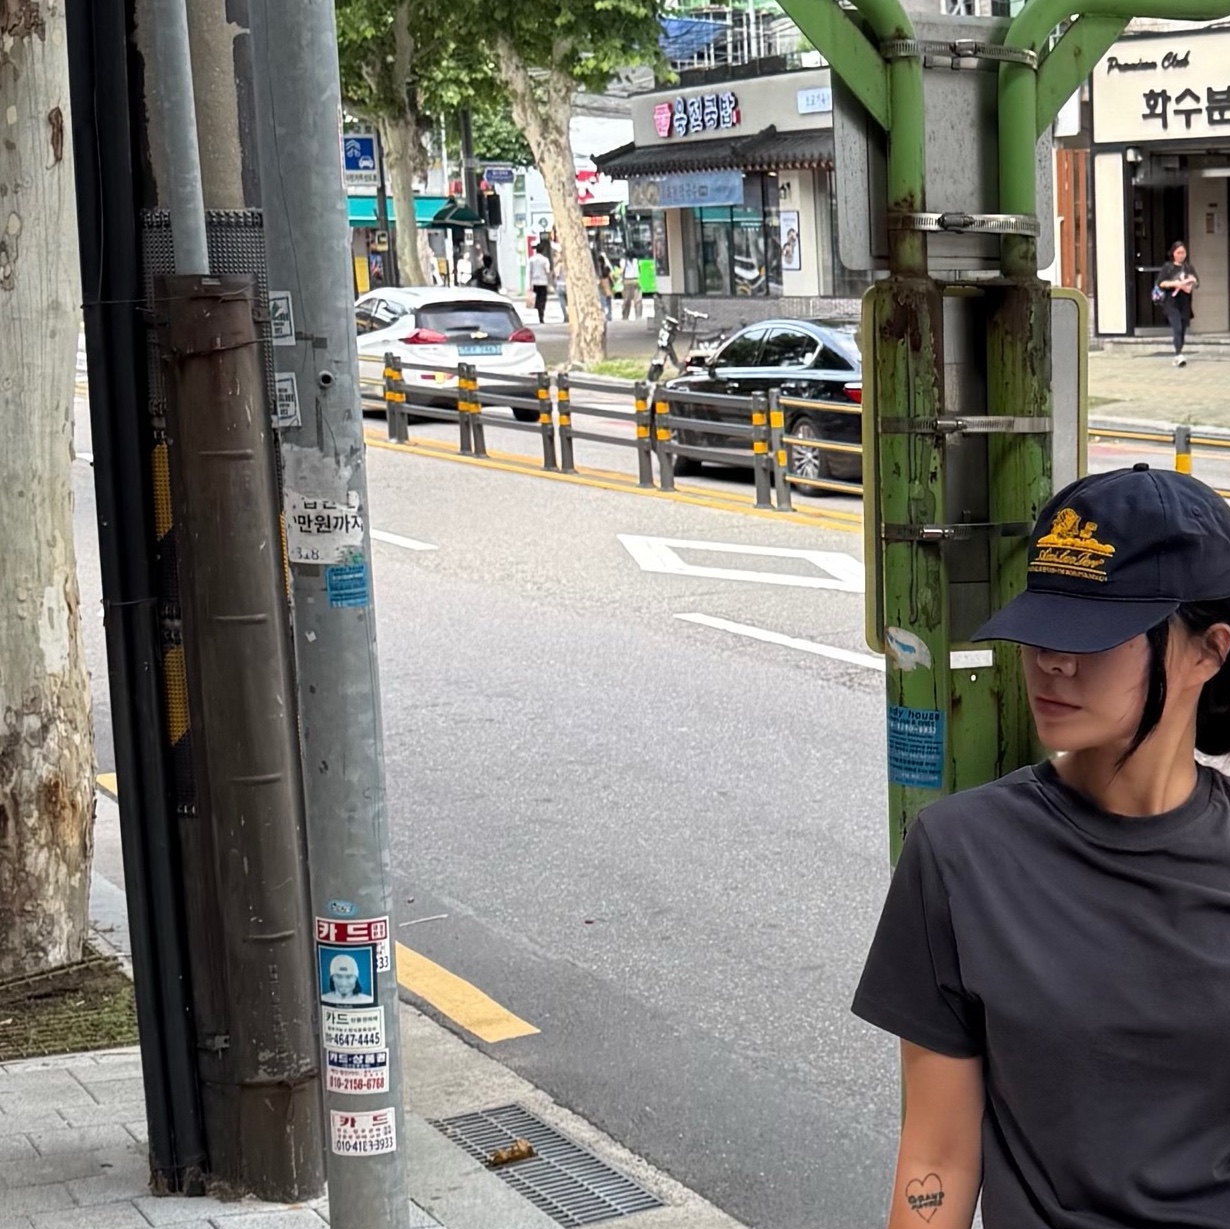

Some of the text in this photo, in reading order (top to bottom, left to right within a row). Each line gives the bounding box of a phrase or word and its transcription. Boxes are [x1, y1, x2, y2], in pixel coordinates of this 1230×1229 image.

[293, 513, 364, 534] 만원까지
[907, 710, 940, 721] house
[318, 921, 369, 942] 카드
[326, 1011, 349, 1025] 카드
[339, 1113, 389, 1128] 카드
